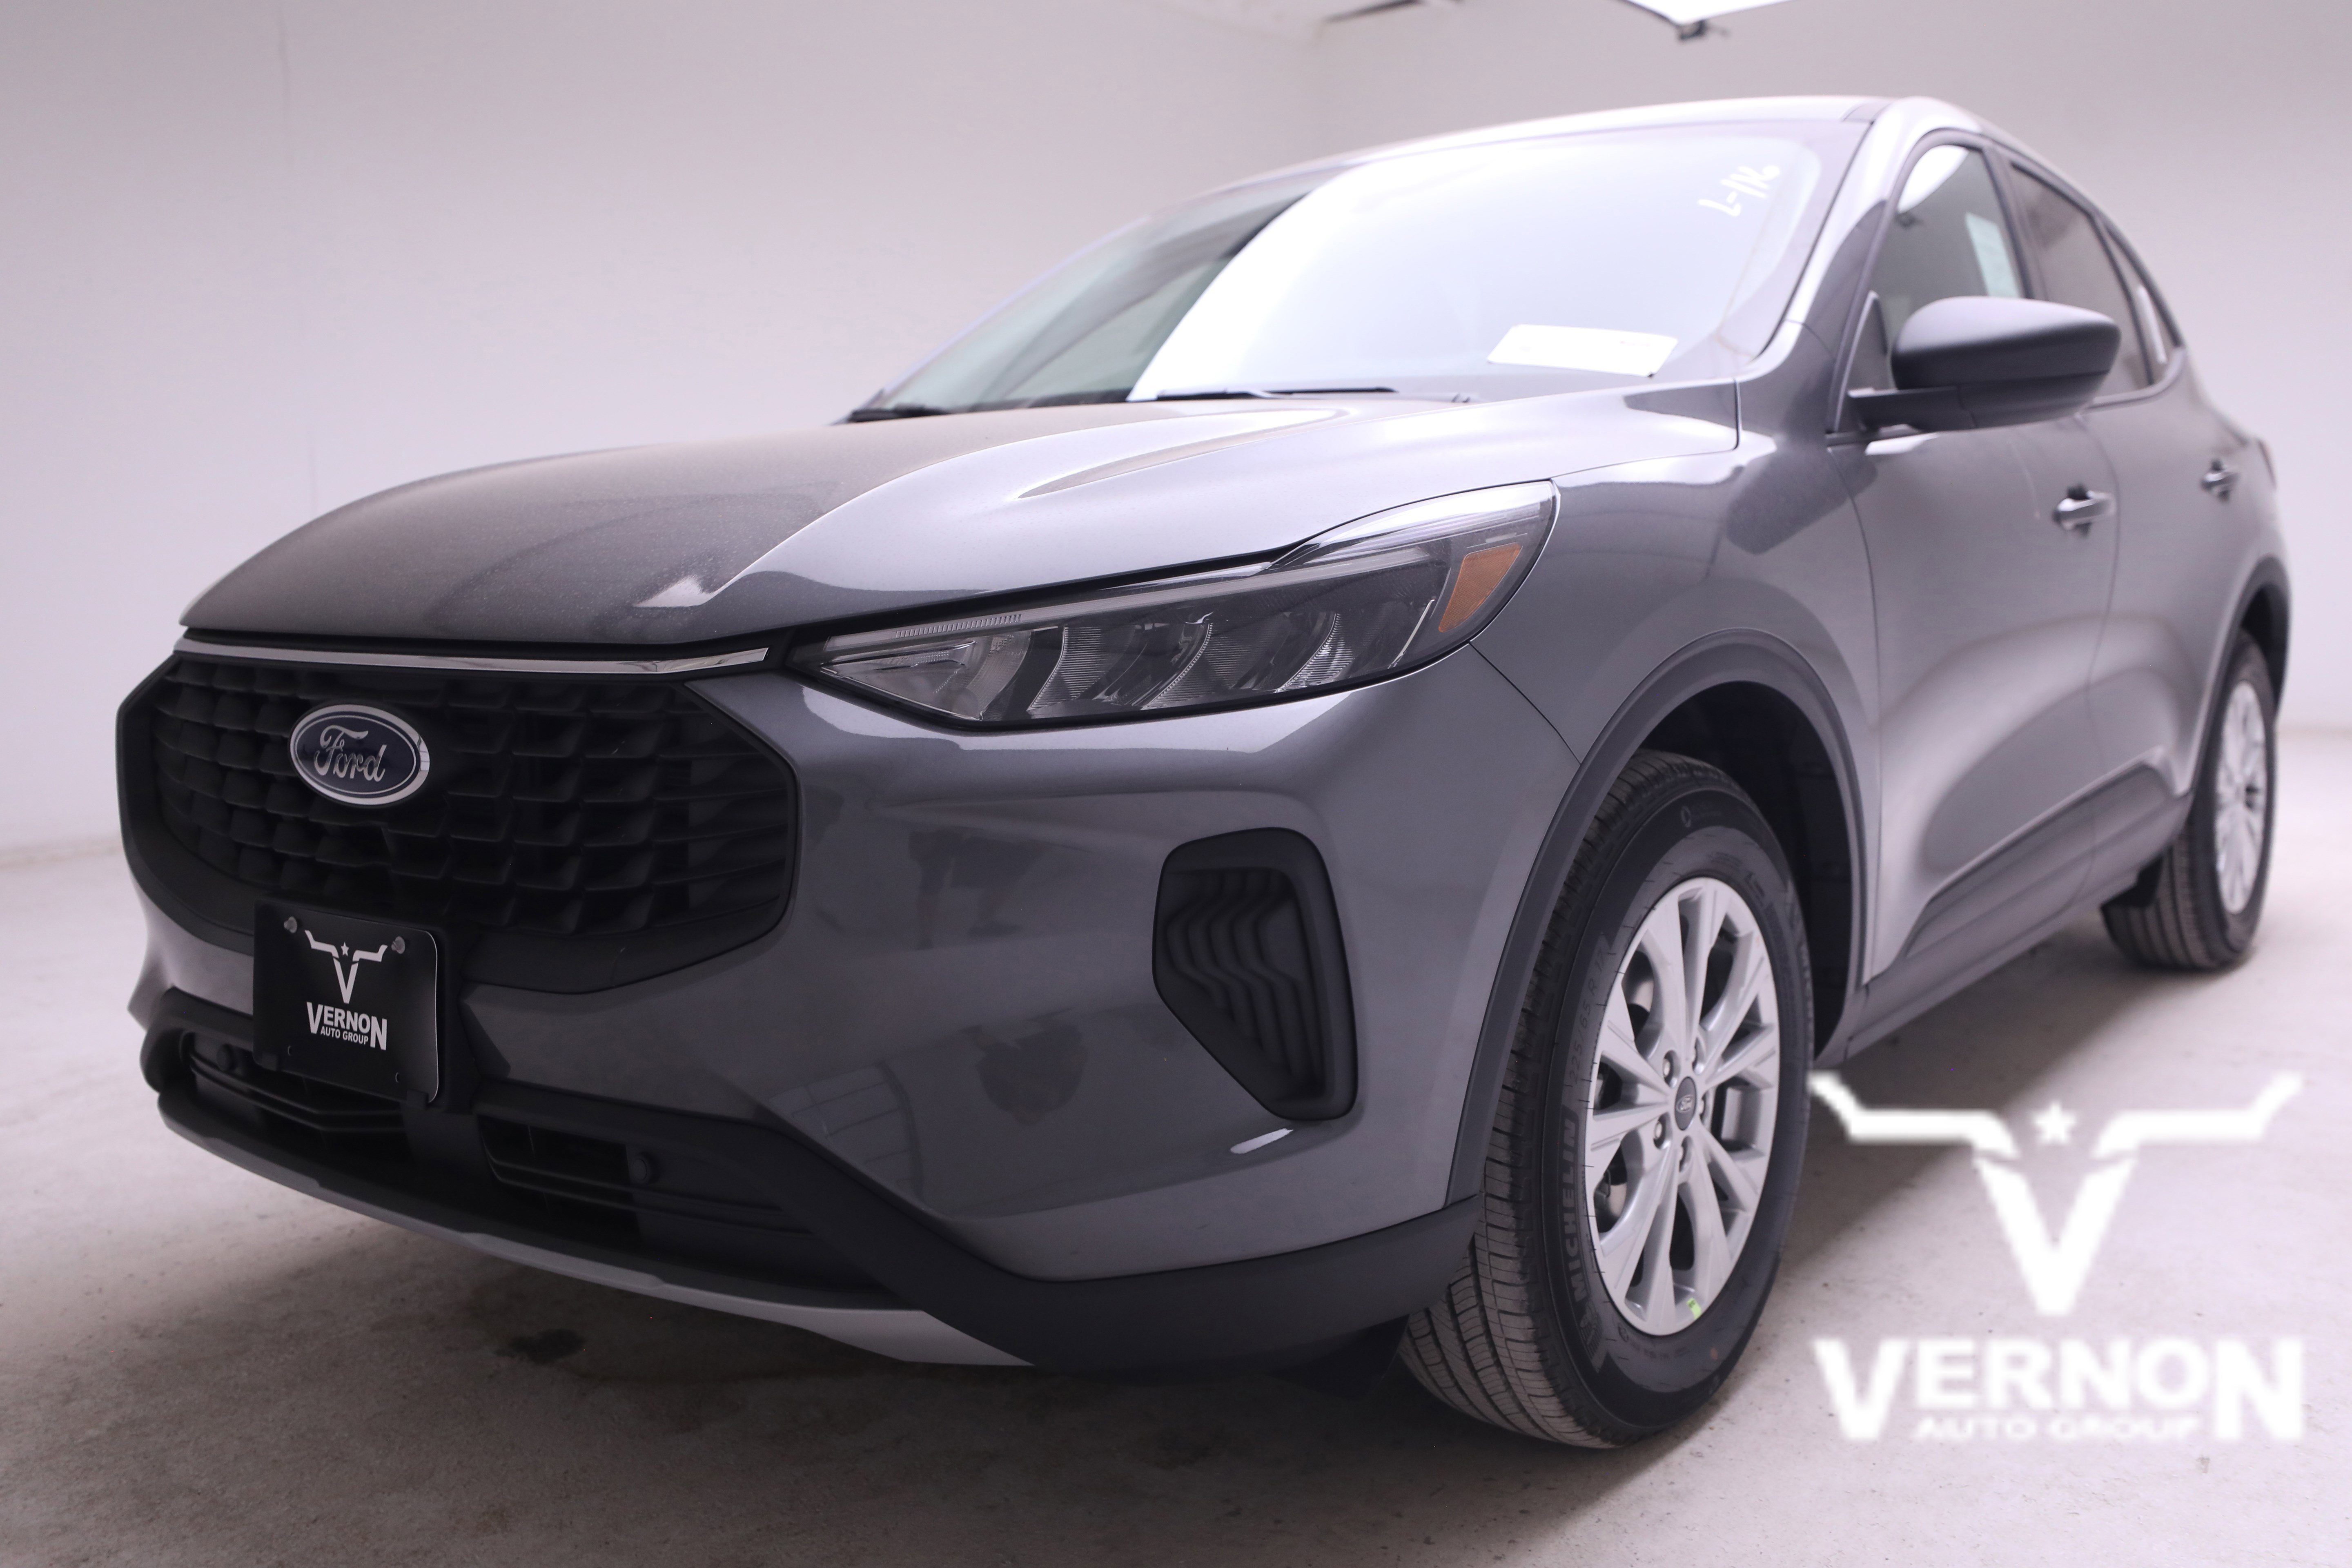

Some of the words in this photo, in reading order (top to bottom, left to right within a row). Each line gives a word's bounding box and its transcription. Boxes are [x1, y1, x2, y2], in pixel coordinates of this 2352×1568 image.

[314, 724, 387, 782] Ford
[306, 1001, 388, 1051] VERNON
[320, 1025, 341, 1039] AUTO
[342, 1031, 369, 1045] GROUP
[1562, 1118, 1587, 1302] MICHELIN
